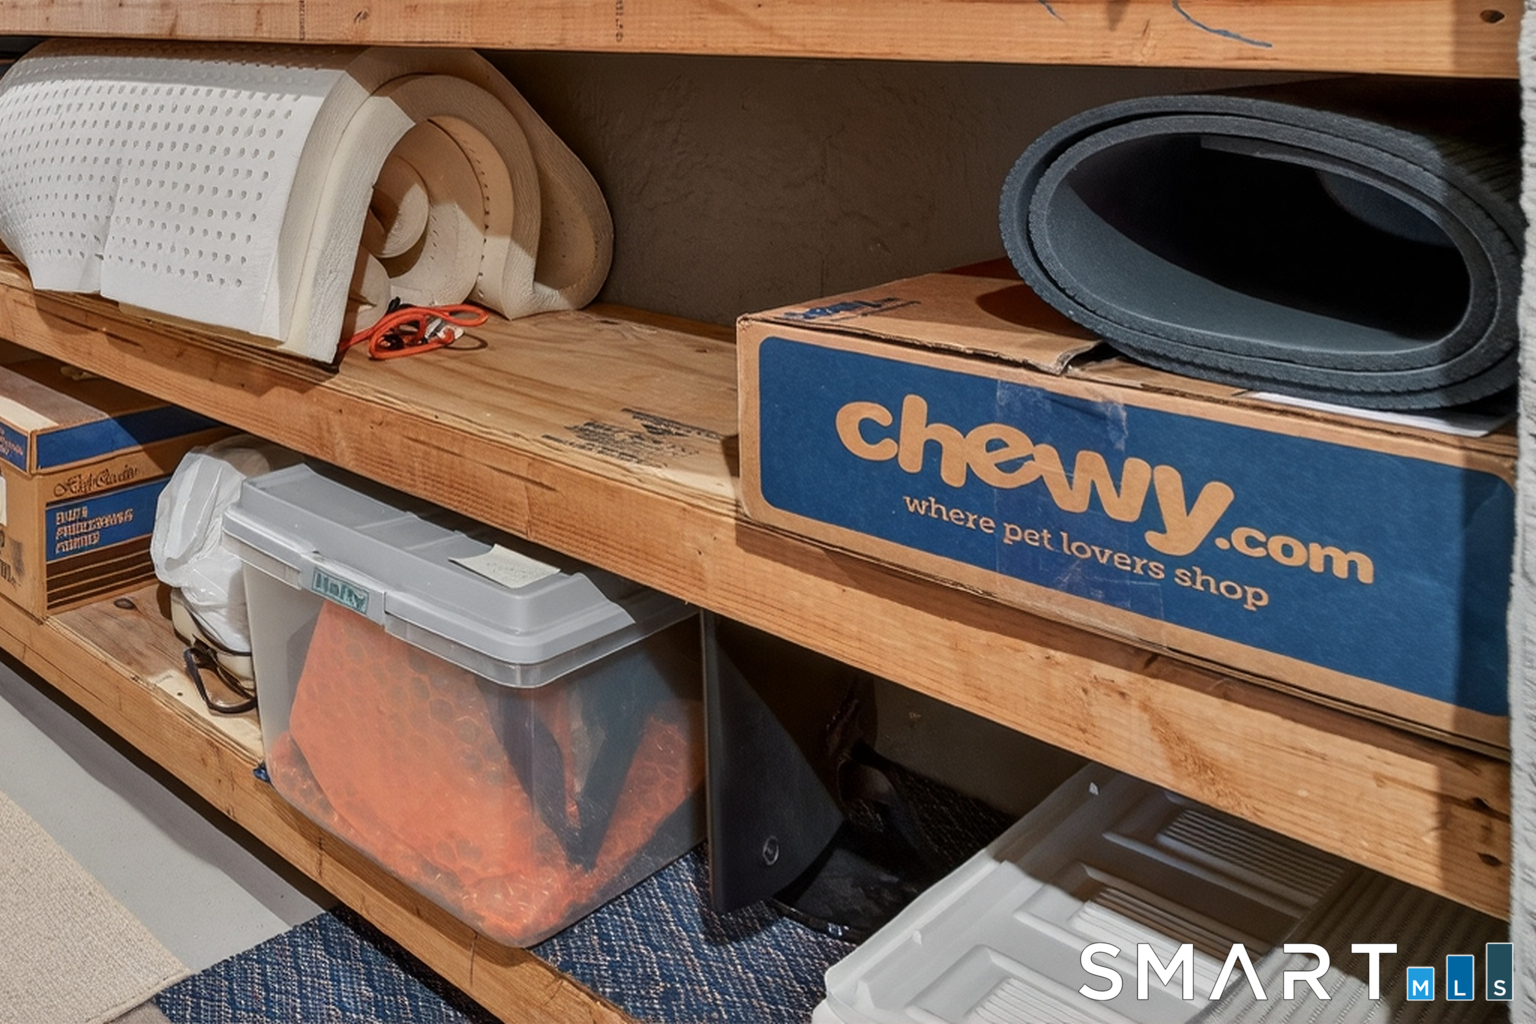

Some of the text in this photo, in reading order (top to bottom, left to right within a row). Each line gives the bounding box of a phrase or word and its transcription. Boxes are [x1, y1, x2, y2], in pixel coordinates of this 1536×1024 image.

[835, 394, 1374, 585] chewy.com
[903, 492, 1269, 611] where pet lovers shop
